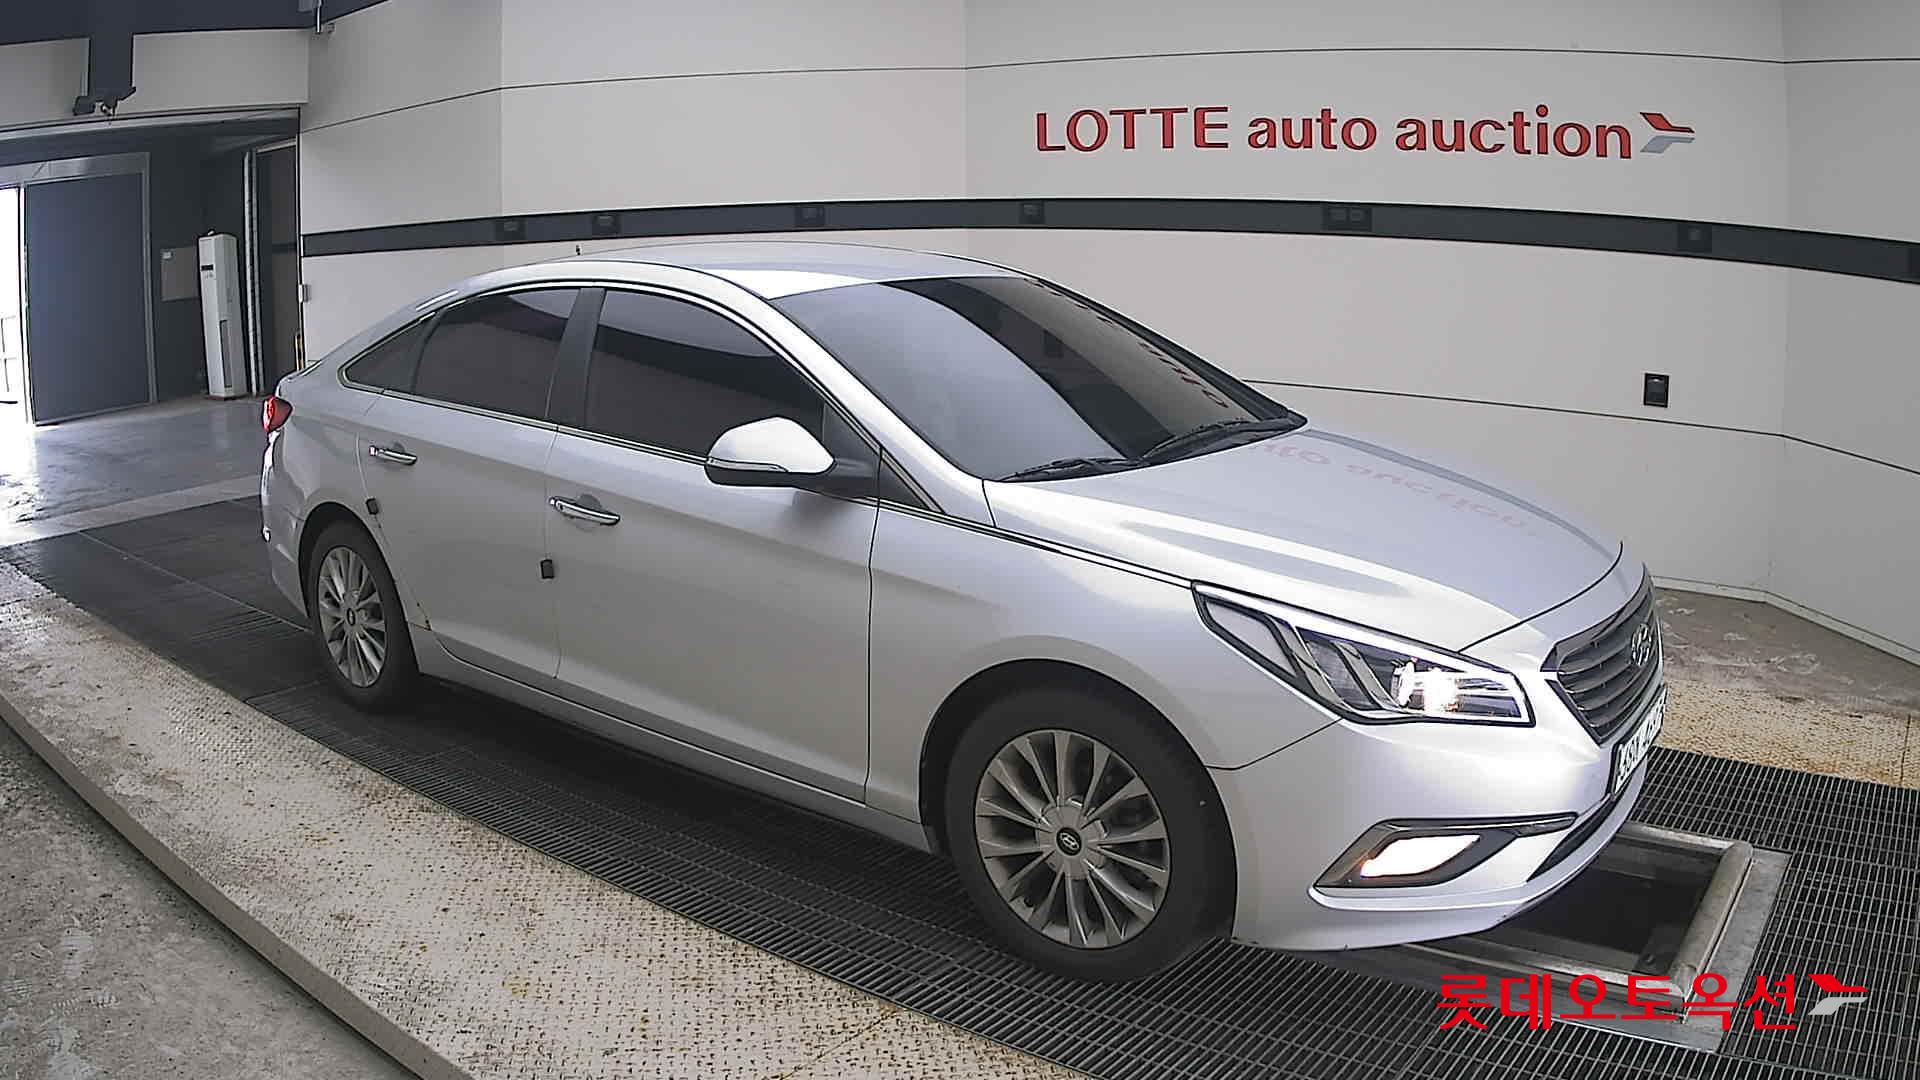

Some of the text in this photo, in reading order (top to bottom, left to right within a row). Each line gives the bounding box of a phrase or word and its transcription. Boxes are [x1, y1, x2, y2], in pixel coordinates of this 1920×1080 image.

[1035, 104, 1632, 159] LOTTE auto auction
